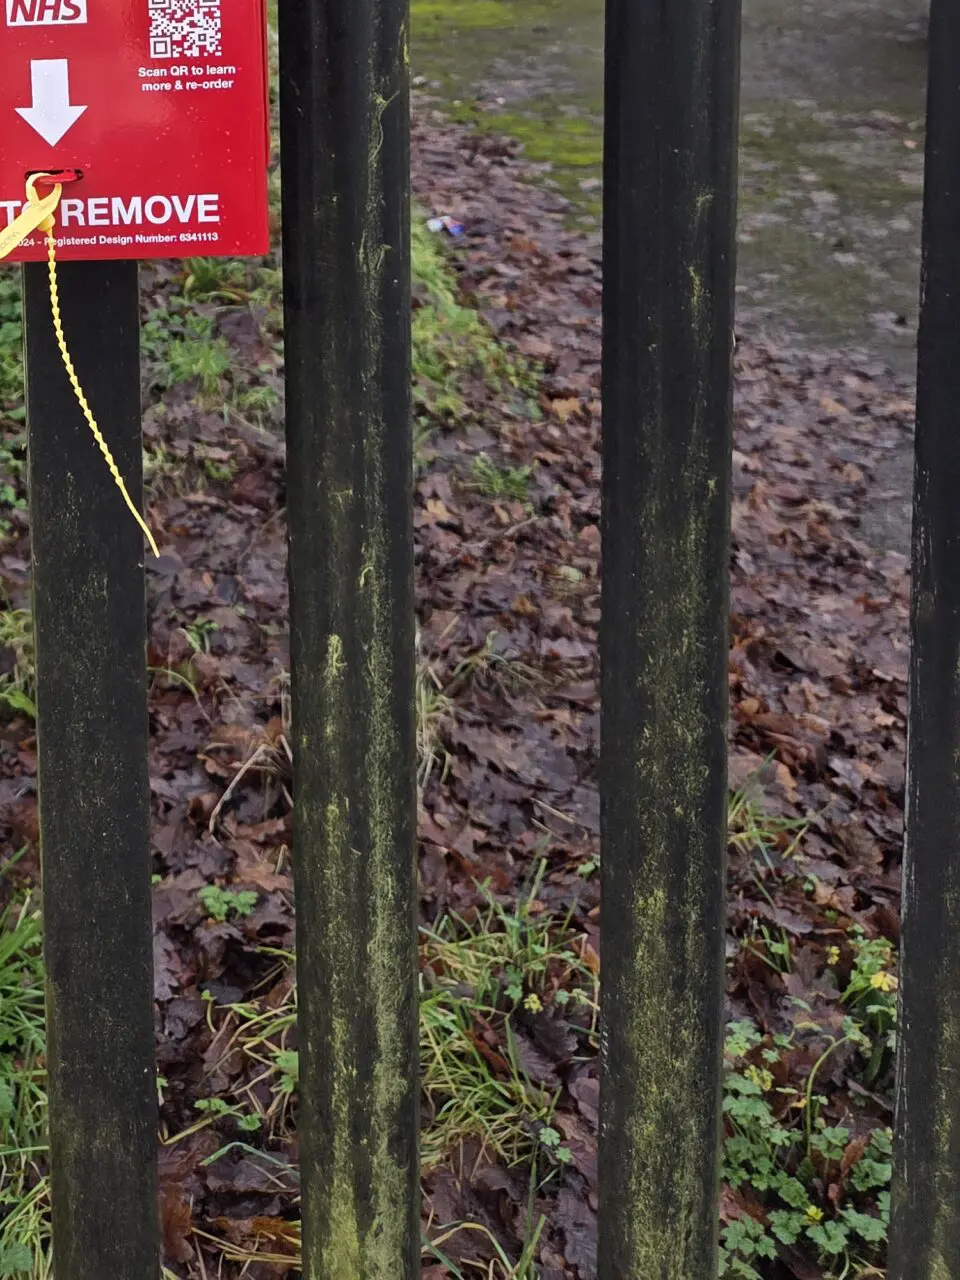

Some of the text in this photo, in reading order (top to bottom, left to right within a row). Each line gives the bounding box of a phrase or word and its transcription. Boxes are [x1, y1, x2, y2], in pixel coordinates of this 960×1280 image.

[138, 64, 236, 78] Scan QR to learn
[141, 78, 234, 92] more & re-order
[61, 194, 220, 226] REMOVE
[98, 234, 133, 246] Design
[135, 233, 177, 244] Number:
[179, 231, 219, 242] 6341113
